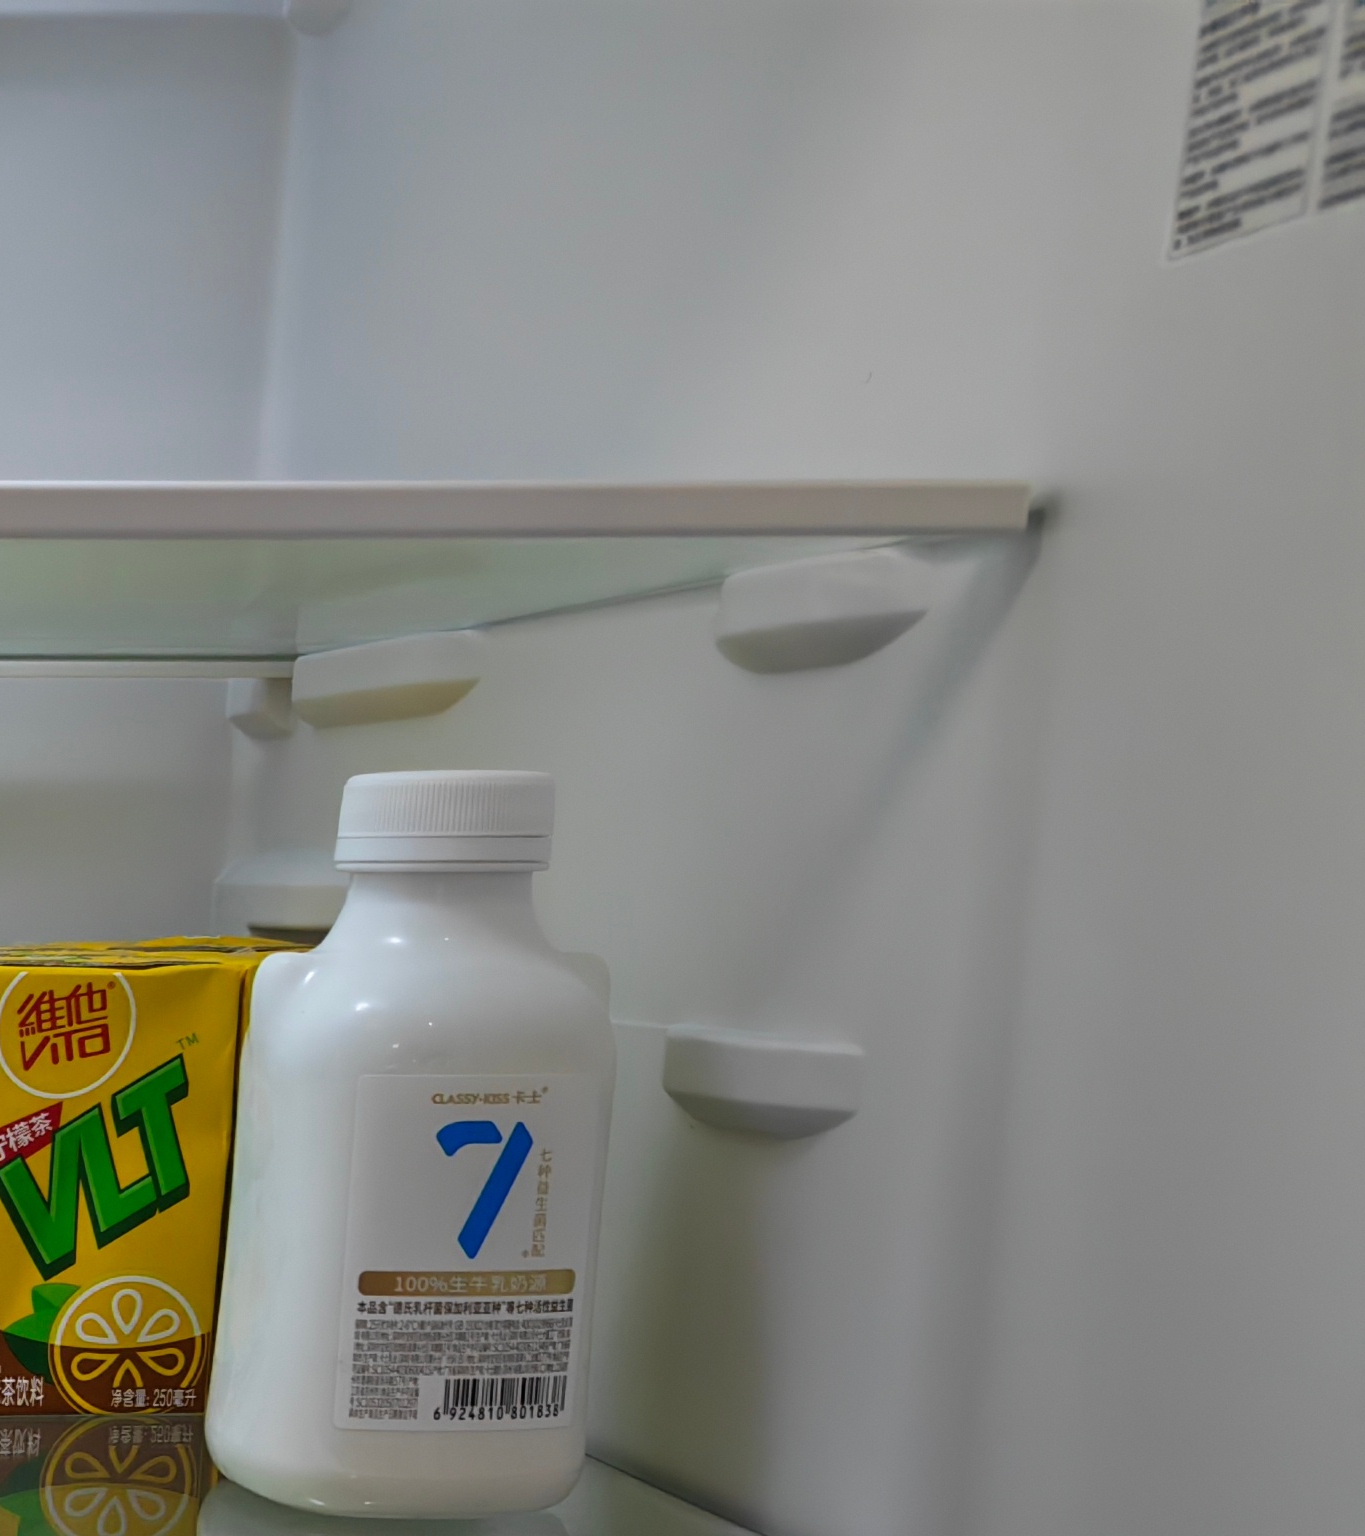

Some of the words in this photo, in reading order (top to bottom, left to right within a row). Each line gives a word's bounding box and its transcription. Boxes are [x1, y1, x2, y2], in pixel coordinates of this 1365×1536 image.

[435, 1120, 534, 1260] 7
[152, 1388, 197, 1408] 250毫升
[433, 1407, 441, 1421] 6
[449, 1405, 505, 1421] 924810
[509, 1402, 560, 1420] 801838
